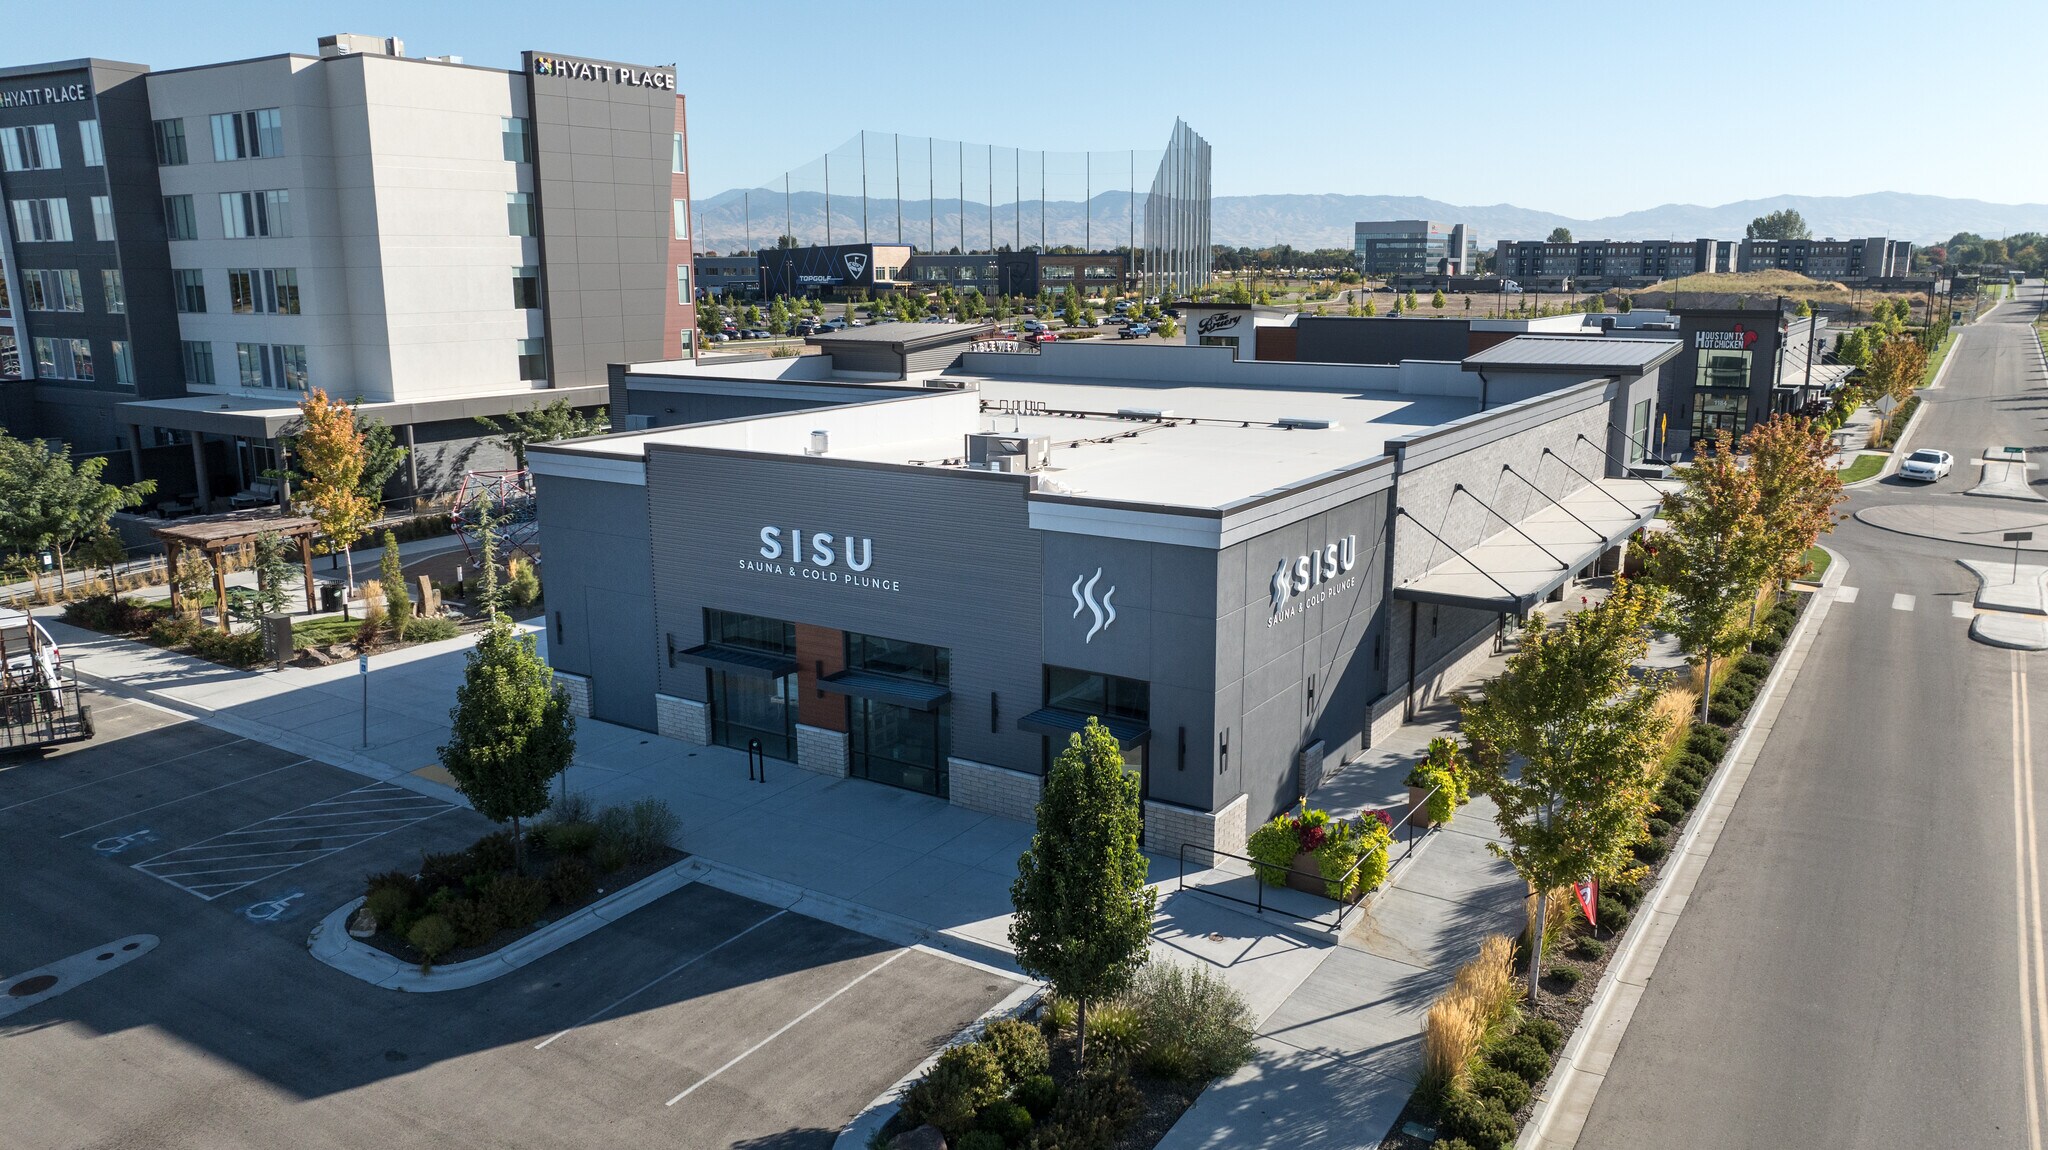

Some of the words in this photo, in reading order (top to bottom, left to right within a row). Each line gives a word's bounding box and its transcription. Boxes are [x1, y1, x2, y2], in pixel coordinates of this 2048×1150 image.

[555, 59, 613, 81] HYATT
[620, 68, 675, 89] PLACE
[3, 89, 40, 107] HYATT
[44, 84, 86, 103] PLACE
[1695, 331, 1734, 348] HOUSTON
[1735, 332, 1744, 340] TX
[1714, 340, 1744, 349] CHICKEN
[760, 526, 873, 572] SISU
[1294, 534, 1356, 592] SISU
[739, 559, 782, 575] SAUNA
[789, 566, 796, 577] &
[802, 568, 838, 582] COLD
[845, 574, 900, 591] PLUNGE
[1267, 606, 1295, 628] SAUNA
[1298, 602, 1304, 613] &
[1306, 591, 1326, 609] COLD
[1328, 576, 1355, 598] PLUNGE
